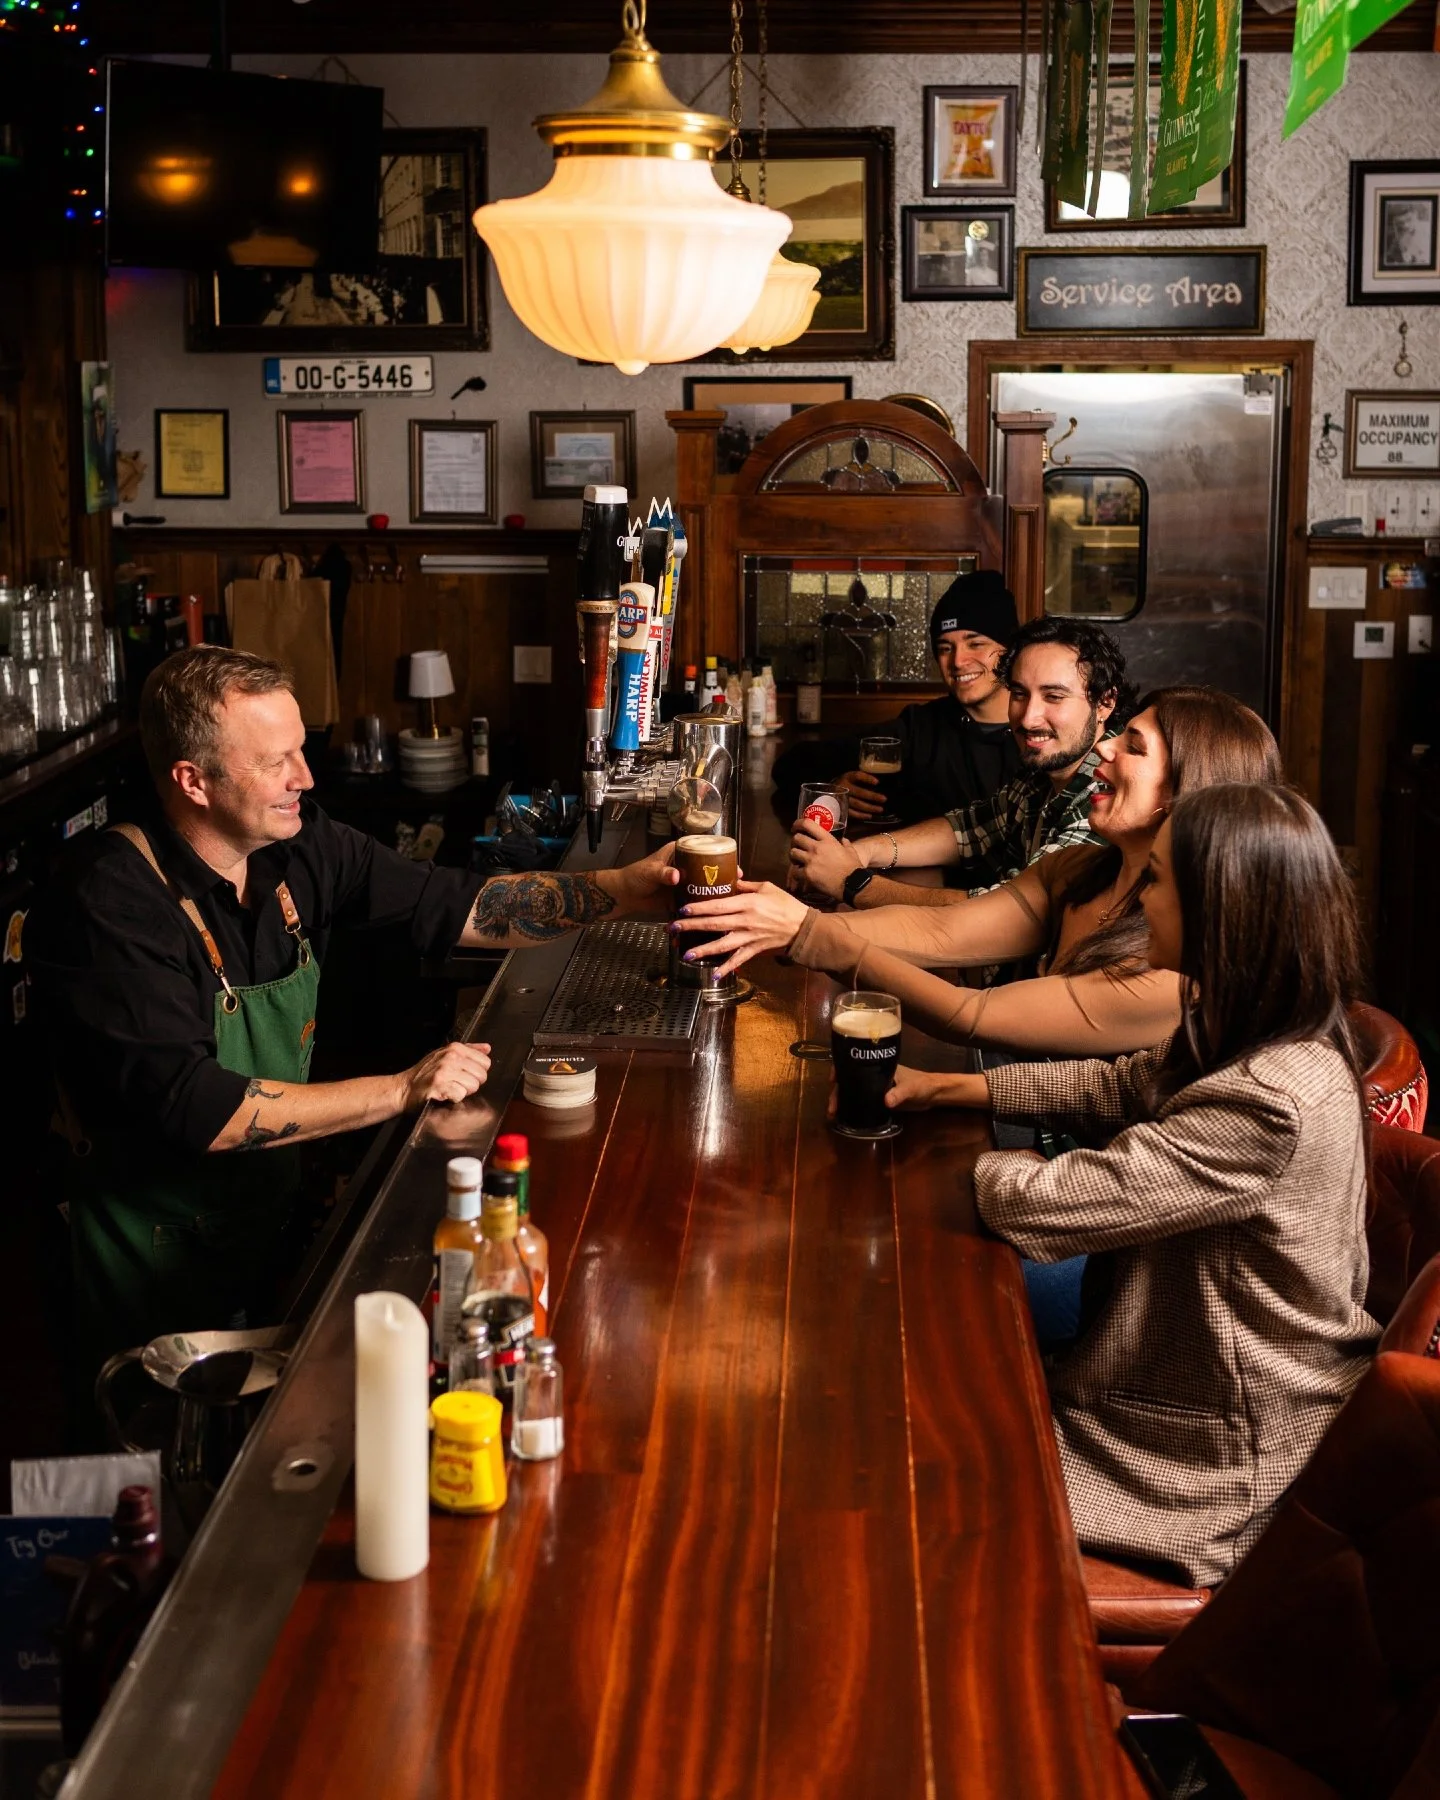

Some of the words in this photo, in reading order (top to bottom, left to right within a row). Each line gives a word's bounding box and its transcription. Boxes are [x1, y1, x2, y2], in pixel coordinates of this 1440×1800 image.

[1040, 276, 1152, 308] Service
[1165, 276, 1242, 308] Area
[296, 364, 412, 389] 00-G-5446
[1369, 414, 1430, 429] MAXIMUM
[1359, 431, 1438, 446] OCCUPANCY
[1388, 451, 1403, 463] 88
[619, 606, 644, 620] ARP
[625, 673, 642, 723] HARP
[687, 884, 732, 896] GUINNESS
[850, 1046, 897, 1060] GUINNESS
